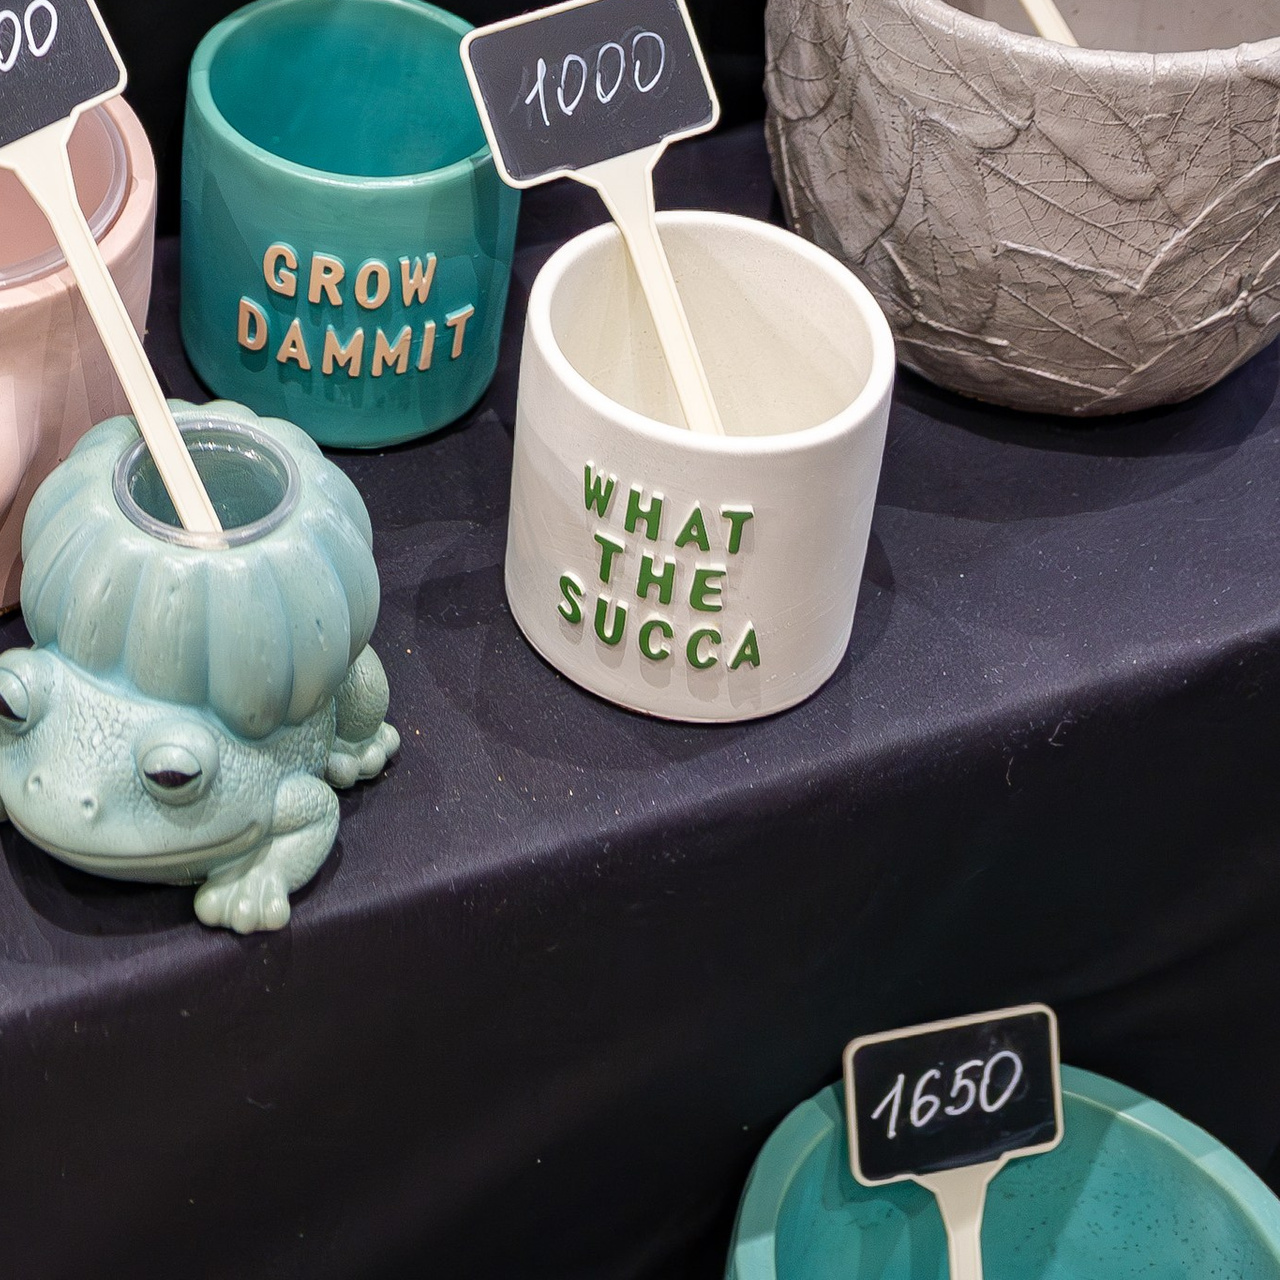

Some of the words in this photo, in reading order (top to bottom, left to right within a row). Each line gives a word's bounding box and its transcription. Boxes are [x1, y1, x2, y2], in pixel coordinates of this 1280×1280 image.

[523, 30, 667, 128] 1000
[262, 242, 438, 309] GROW
[237, 296, 475, 378] DAMMIT
[584, 460, 755, 555] WHAT
[593, 530, 727, 612] THE
[557, 571, 761, 670] SUCCA
[870, 1050, 1023, 1139] 1650
